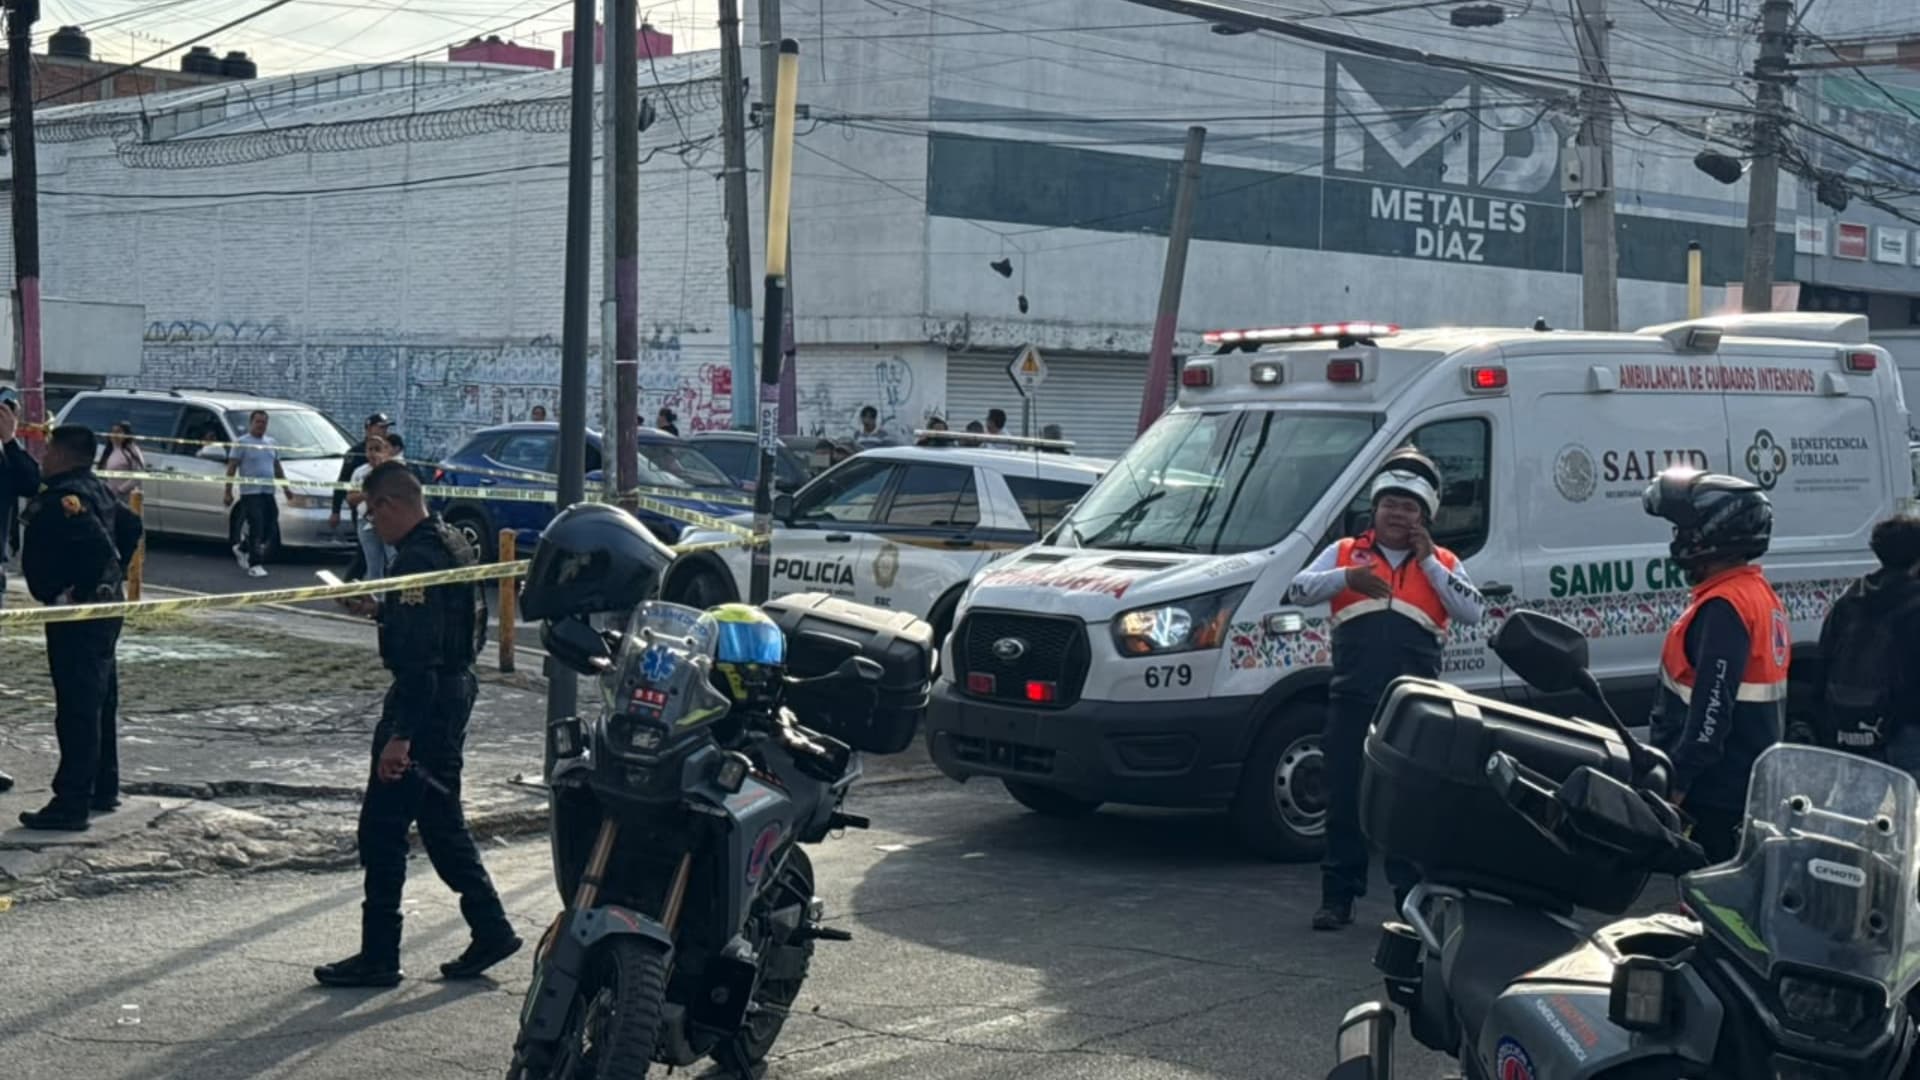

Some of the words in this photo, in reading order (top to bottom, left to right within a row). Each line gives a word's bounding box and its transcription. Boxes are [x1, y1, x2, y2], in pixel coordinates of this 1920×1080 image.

[1371, 187, 1527, 233] METALES
[1415, 224, 1485, 262] DÍAZ
[1619, 364, 1688, 390] AMBULANCIA
[1688, 365, 1703, 390] DE
[1705, 366, 1756, 391] CUIDADOS
[1758, 367, 1815, 392] INTENSIVOS
[1791, 437, 1868, 450] BENEFICENCIA
[1792, 449, 1839, 466] PÚBLICA
[773, 556, 855, 586] POLICÍA
[1549, 560, 1634, 598] SAMU
[1145, 664, 1193, 688] 679
